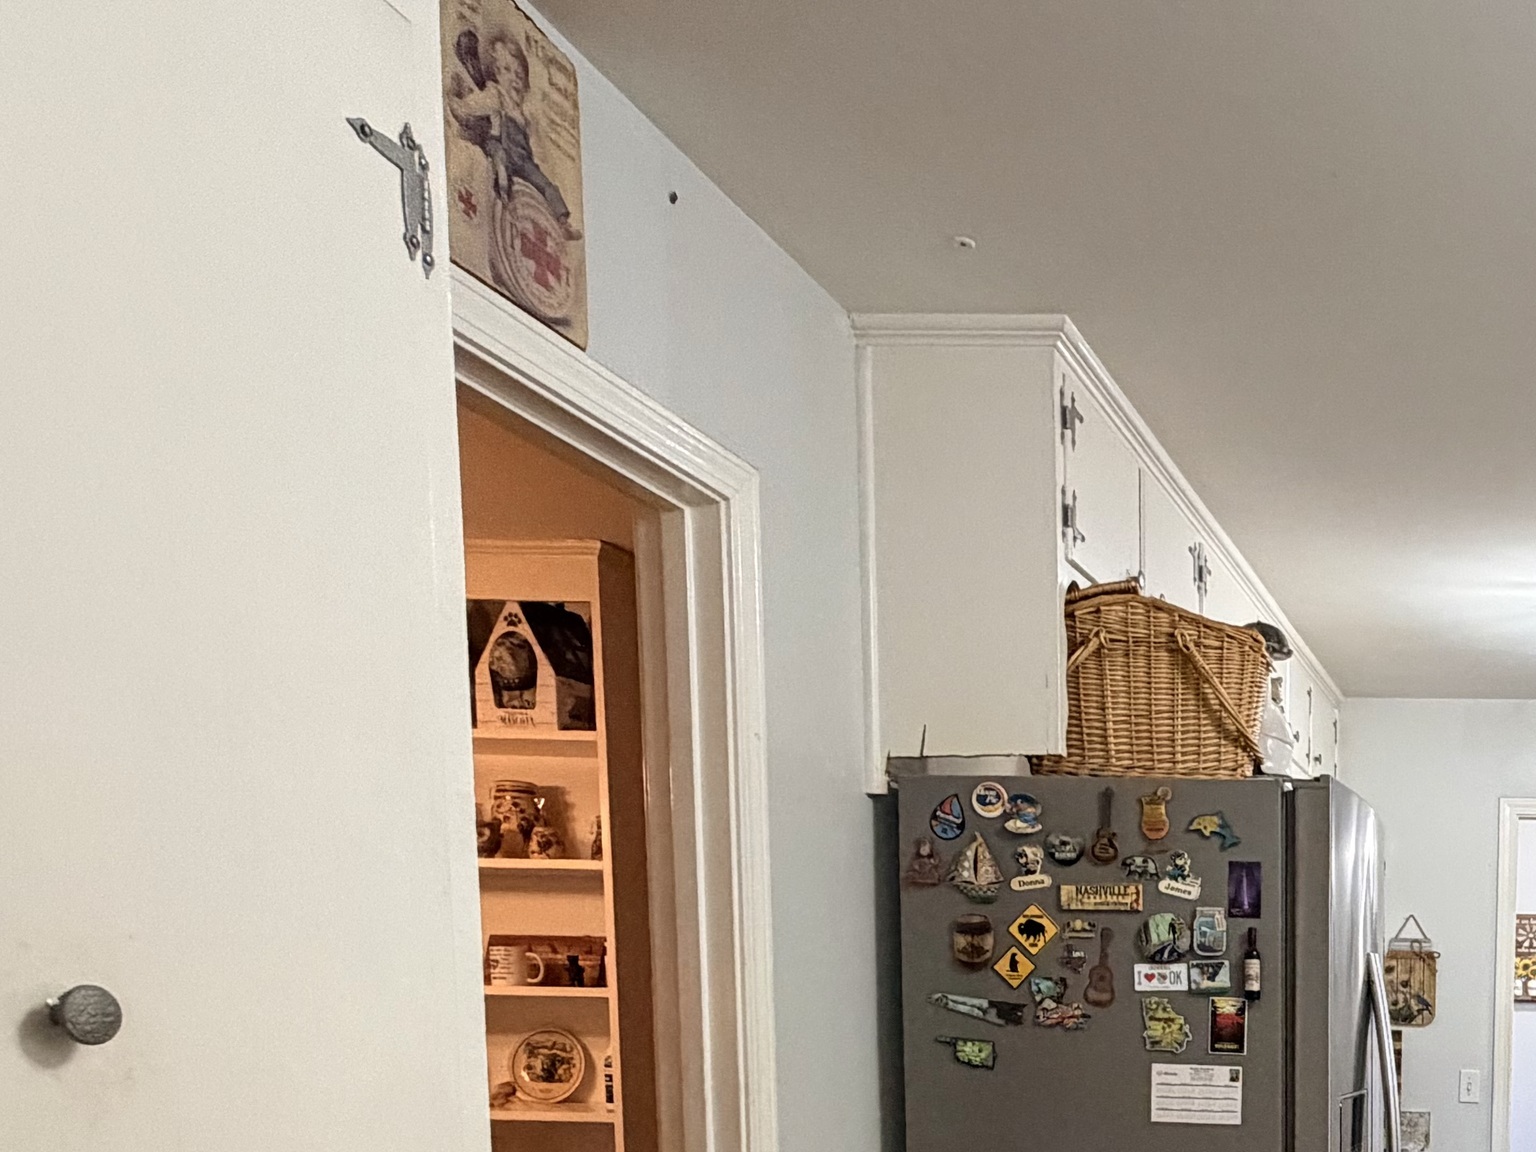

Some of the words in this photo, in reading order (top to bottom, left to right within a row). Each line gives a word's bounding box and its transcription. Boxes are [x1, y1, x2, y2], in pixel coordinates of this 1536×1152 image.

[1017, 878, 1046, 888] Donna
[1164, 882, 1192, 896] James
[1075, 884, 1130, 898] NASHVILLE
[1169, 970, 1183, 986] OK
